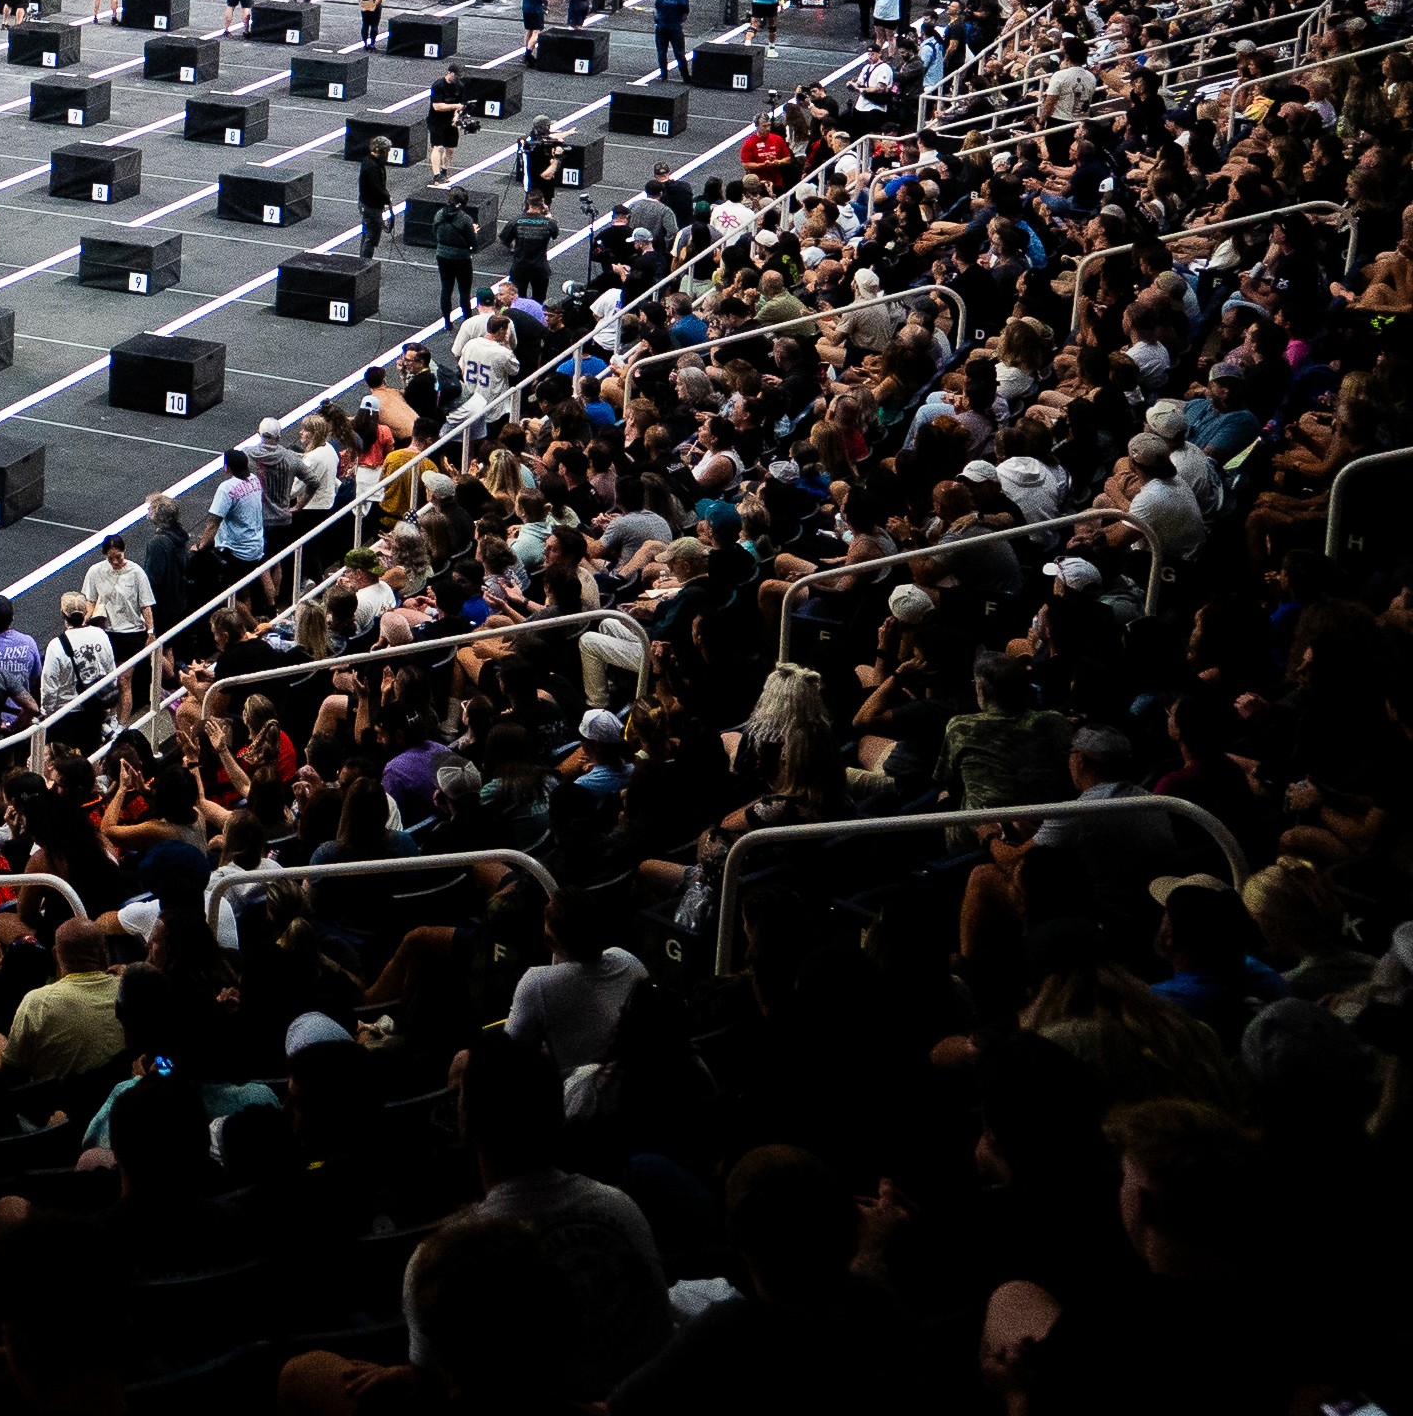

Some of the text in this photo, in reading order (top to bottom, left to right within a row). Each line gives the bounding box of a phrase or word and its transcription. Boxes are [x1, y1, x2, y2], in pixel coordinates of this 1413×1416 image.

[333, 304, 347, 320] 10
[464, 362, 492, 386] 25
[170, 395, 184, 413] 10
